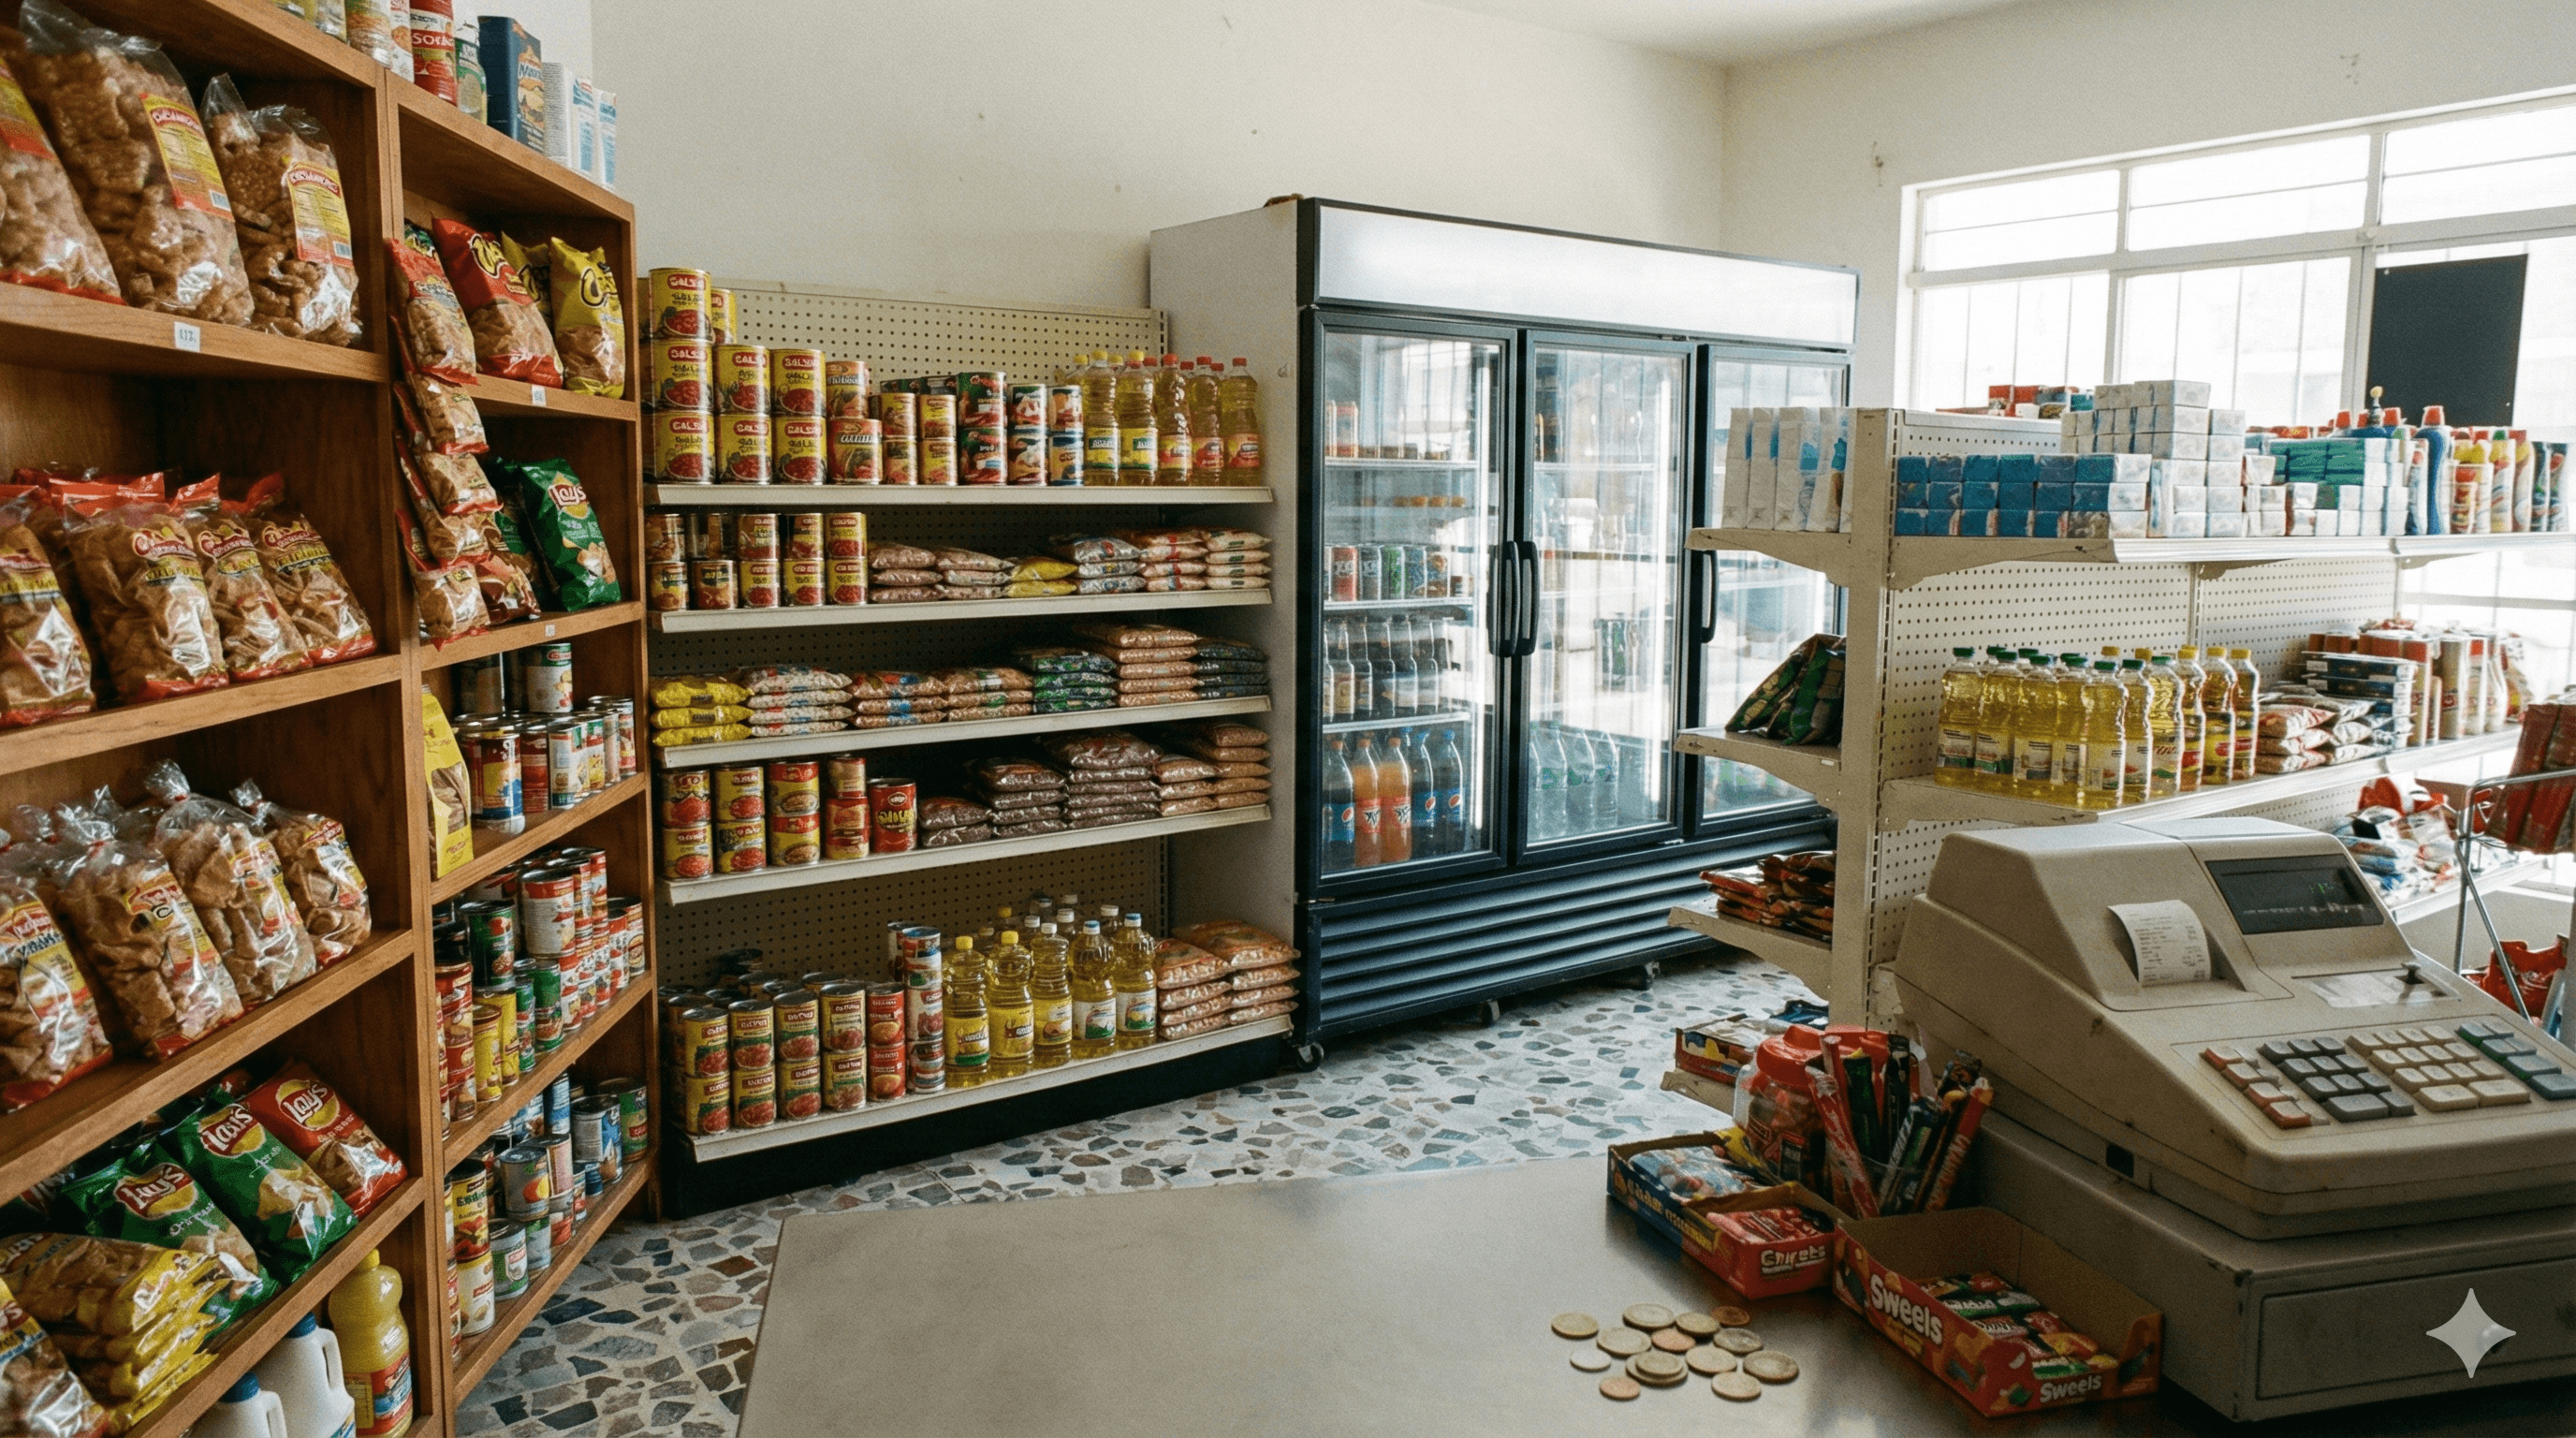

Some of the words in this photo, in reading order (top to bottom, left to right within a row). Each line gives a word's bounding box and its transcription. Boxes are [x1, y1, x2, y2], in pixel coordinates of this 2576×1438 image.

[669, 276, 705, 288] SALS
[670, 348, 706, 360] SALS
[787, 425, 821, 436] SALS
[1870, 1274, 1943, 1344] Sweels
[2040, 1375, 2101, 1403] Sweels
